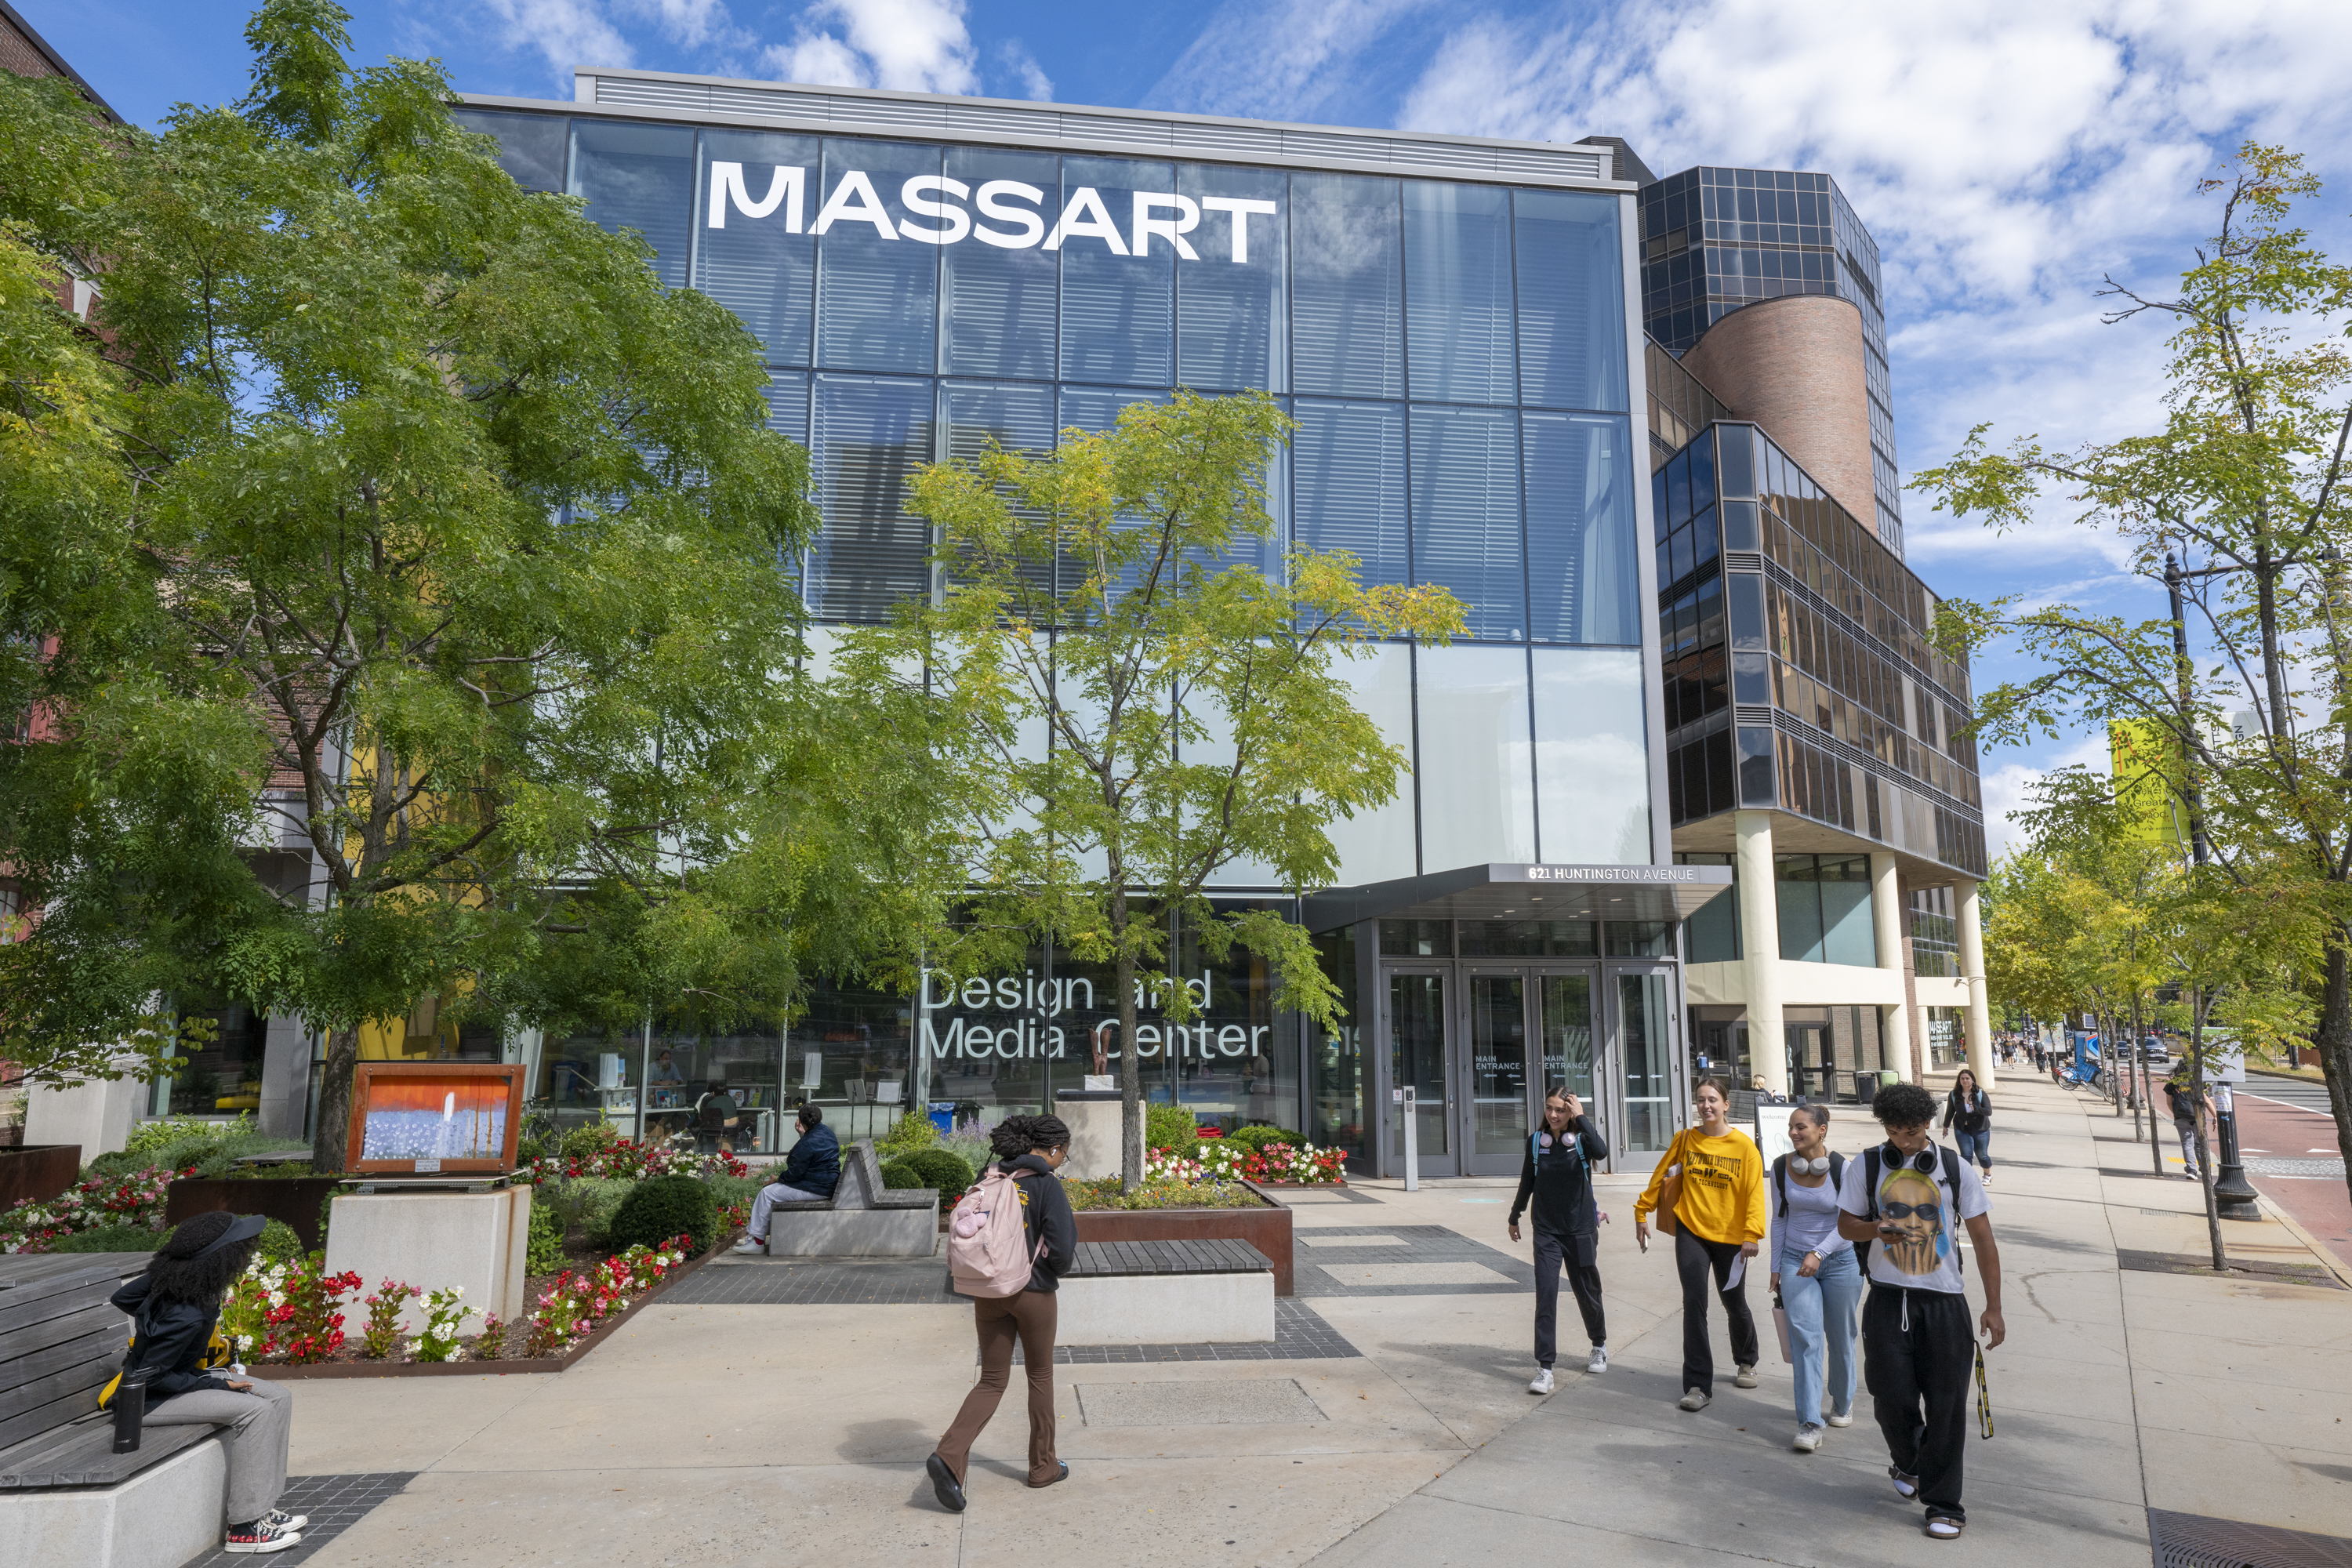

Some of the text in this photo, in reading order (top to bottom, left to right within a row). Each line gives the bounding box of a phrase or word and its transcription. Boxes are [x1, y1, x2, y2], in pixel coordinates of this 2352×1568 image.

[708, 161, 1276, 263] MASSART
[1529, 868, 1694, 881] 621 HUNTINGTON AVENUE
[921, 968, 1093, 1018] Design
[920, 1018, 1269, 1059] Media Center
[1715, 1155, 1740, 1179] INSTITUTE
[1699, 1178, 1729, 1190] TECHNOLOGY
